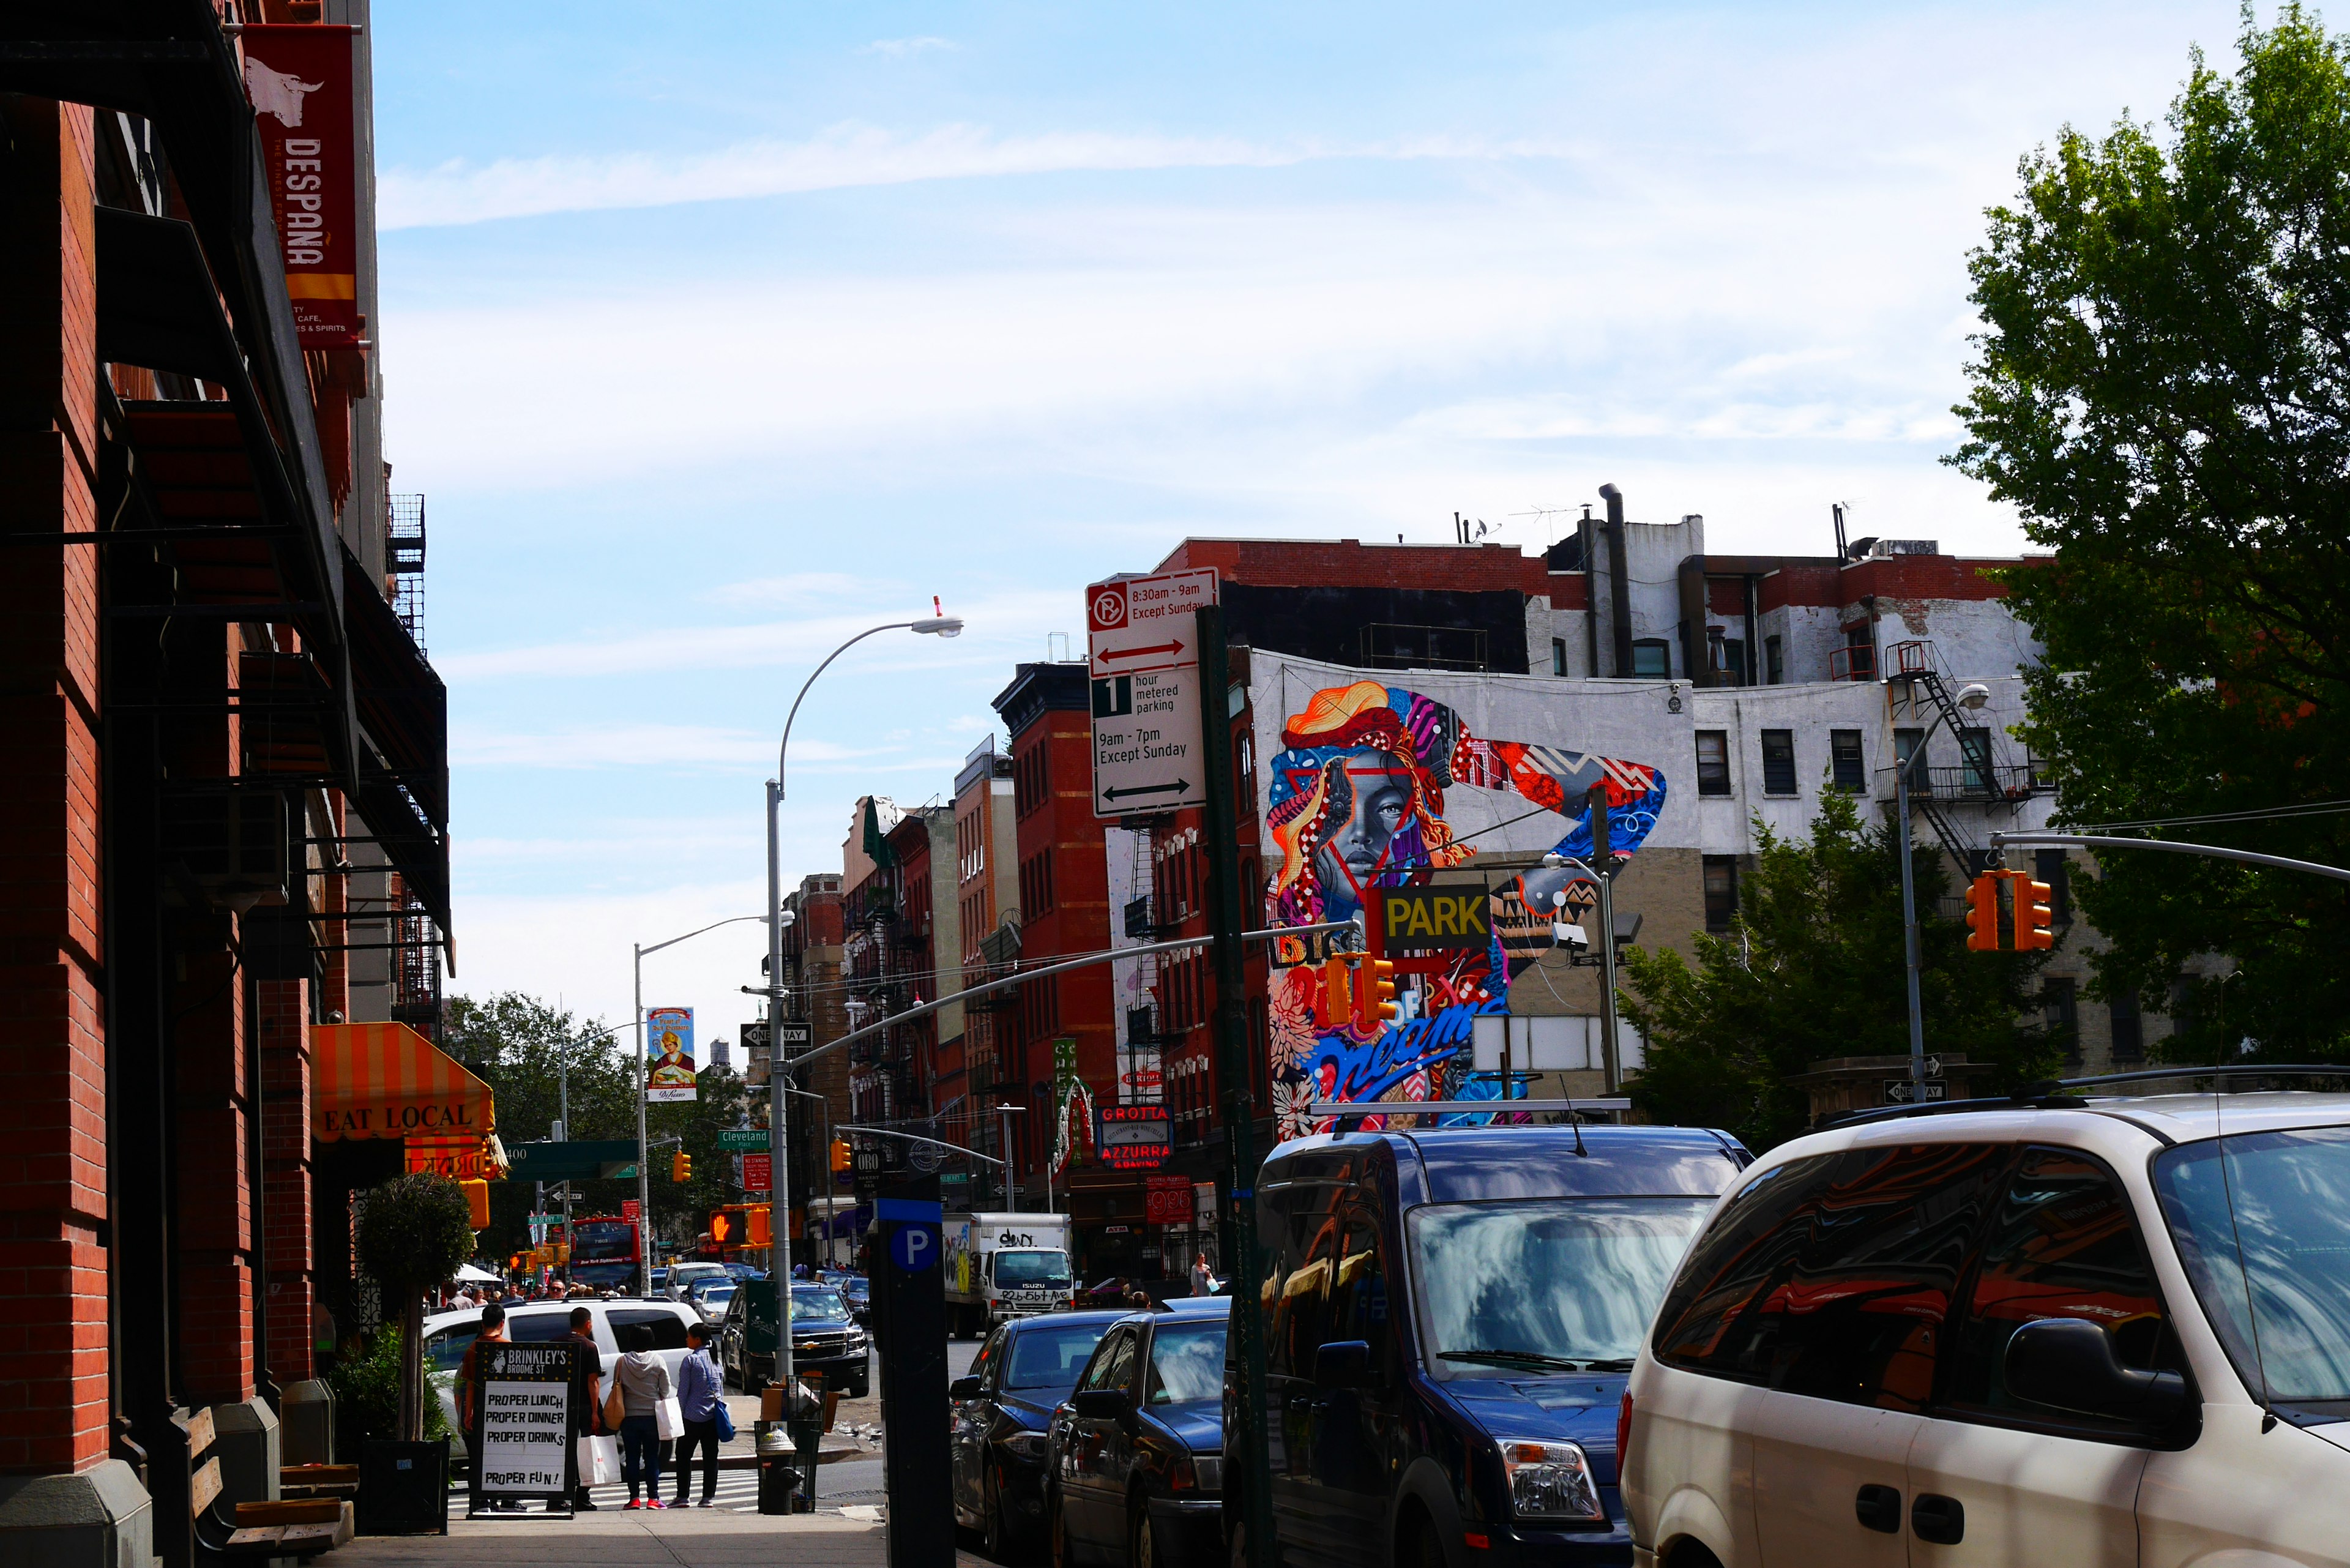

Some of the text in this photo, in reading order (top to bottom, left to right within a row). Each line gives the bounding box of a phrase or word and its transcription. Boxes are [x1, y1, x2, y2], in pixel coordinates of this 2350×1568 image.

[1132, 588, 1169, 602] 8:30am
[1178, 584, 1200, 595] 9am
[1133, 605, 1165, 619] Except
[1136, 676, 1158, 687] hour
[1136, 684, 1179, 700] metered
[1136, 700, 1174, 715] parking
[1099, 733, 1124, 747] 9am
[1136, 728, 1160, 744] 7pm
[1100, 742, 1187, 764] Except Sunday
[1387, 895, 1488, 937] PARK
[752, 1031, 771, 1040] ONE
[1894, 1088, 1911, 1096] ONE
[323, 1104, 472, 1132] EAT LOCAL
[1102, 1106, 1169, 1122] GROTTA
[722, 1132, 767, 1141] Cleveland
[506, 1148, 527, 1160] 400
[1102, 1145, 1170, 1161] AZZURRA
[857, 1153, 879, 1171] ORO
[906, 1230, 929, 1265] P
[507, 1350, 567, 1365] BRINKLEY'S
[507, 1364, 534, 1375] BROOME
[488, 1394, 563, 1409] PROPER LUNCH
[485, 1411, 564, 1424] PROPER DINNER
[487, 1431, 565, 1446] PROPER DRINKS
[485, 1472, 526, 1485] PROPER
[529, 1471, 551, 1485] FUN
